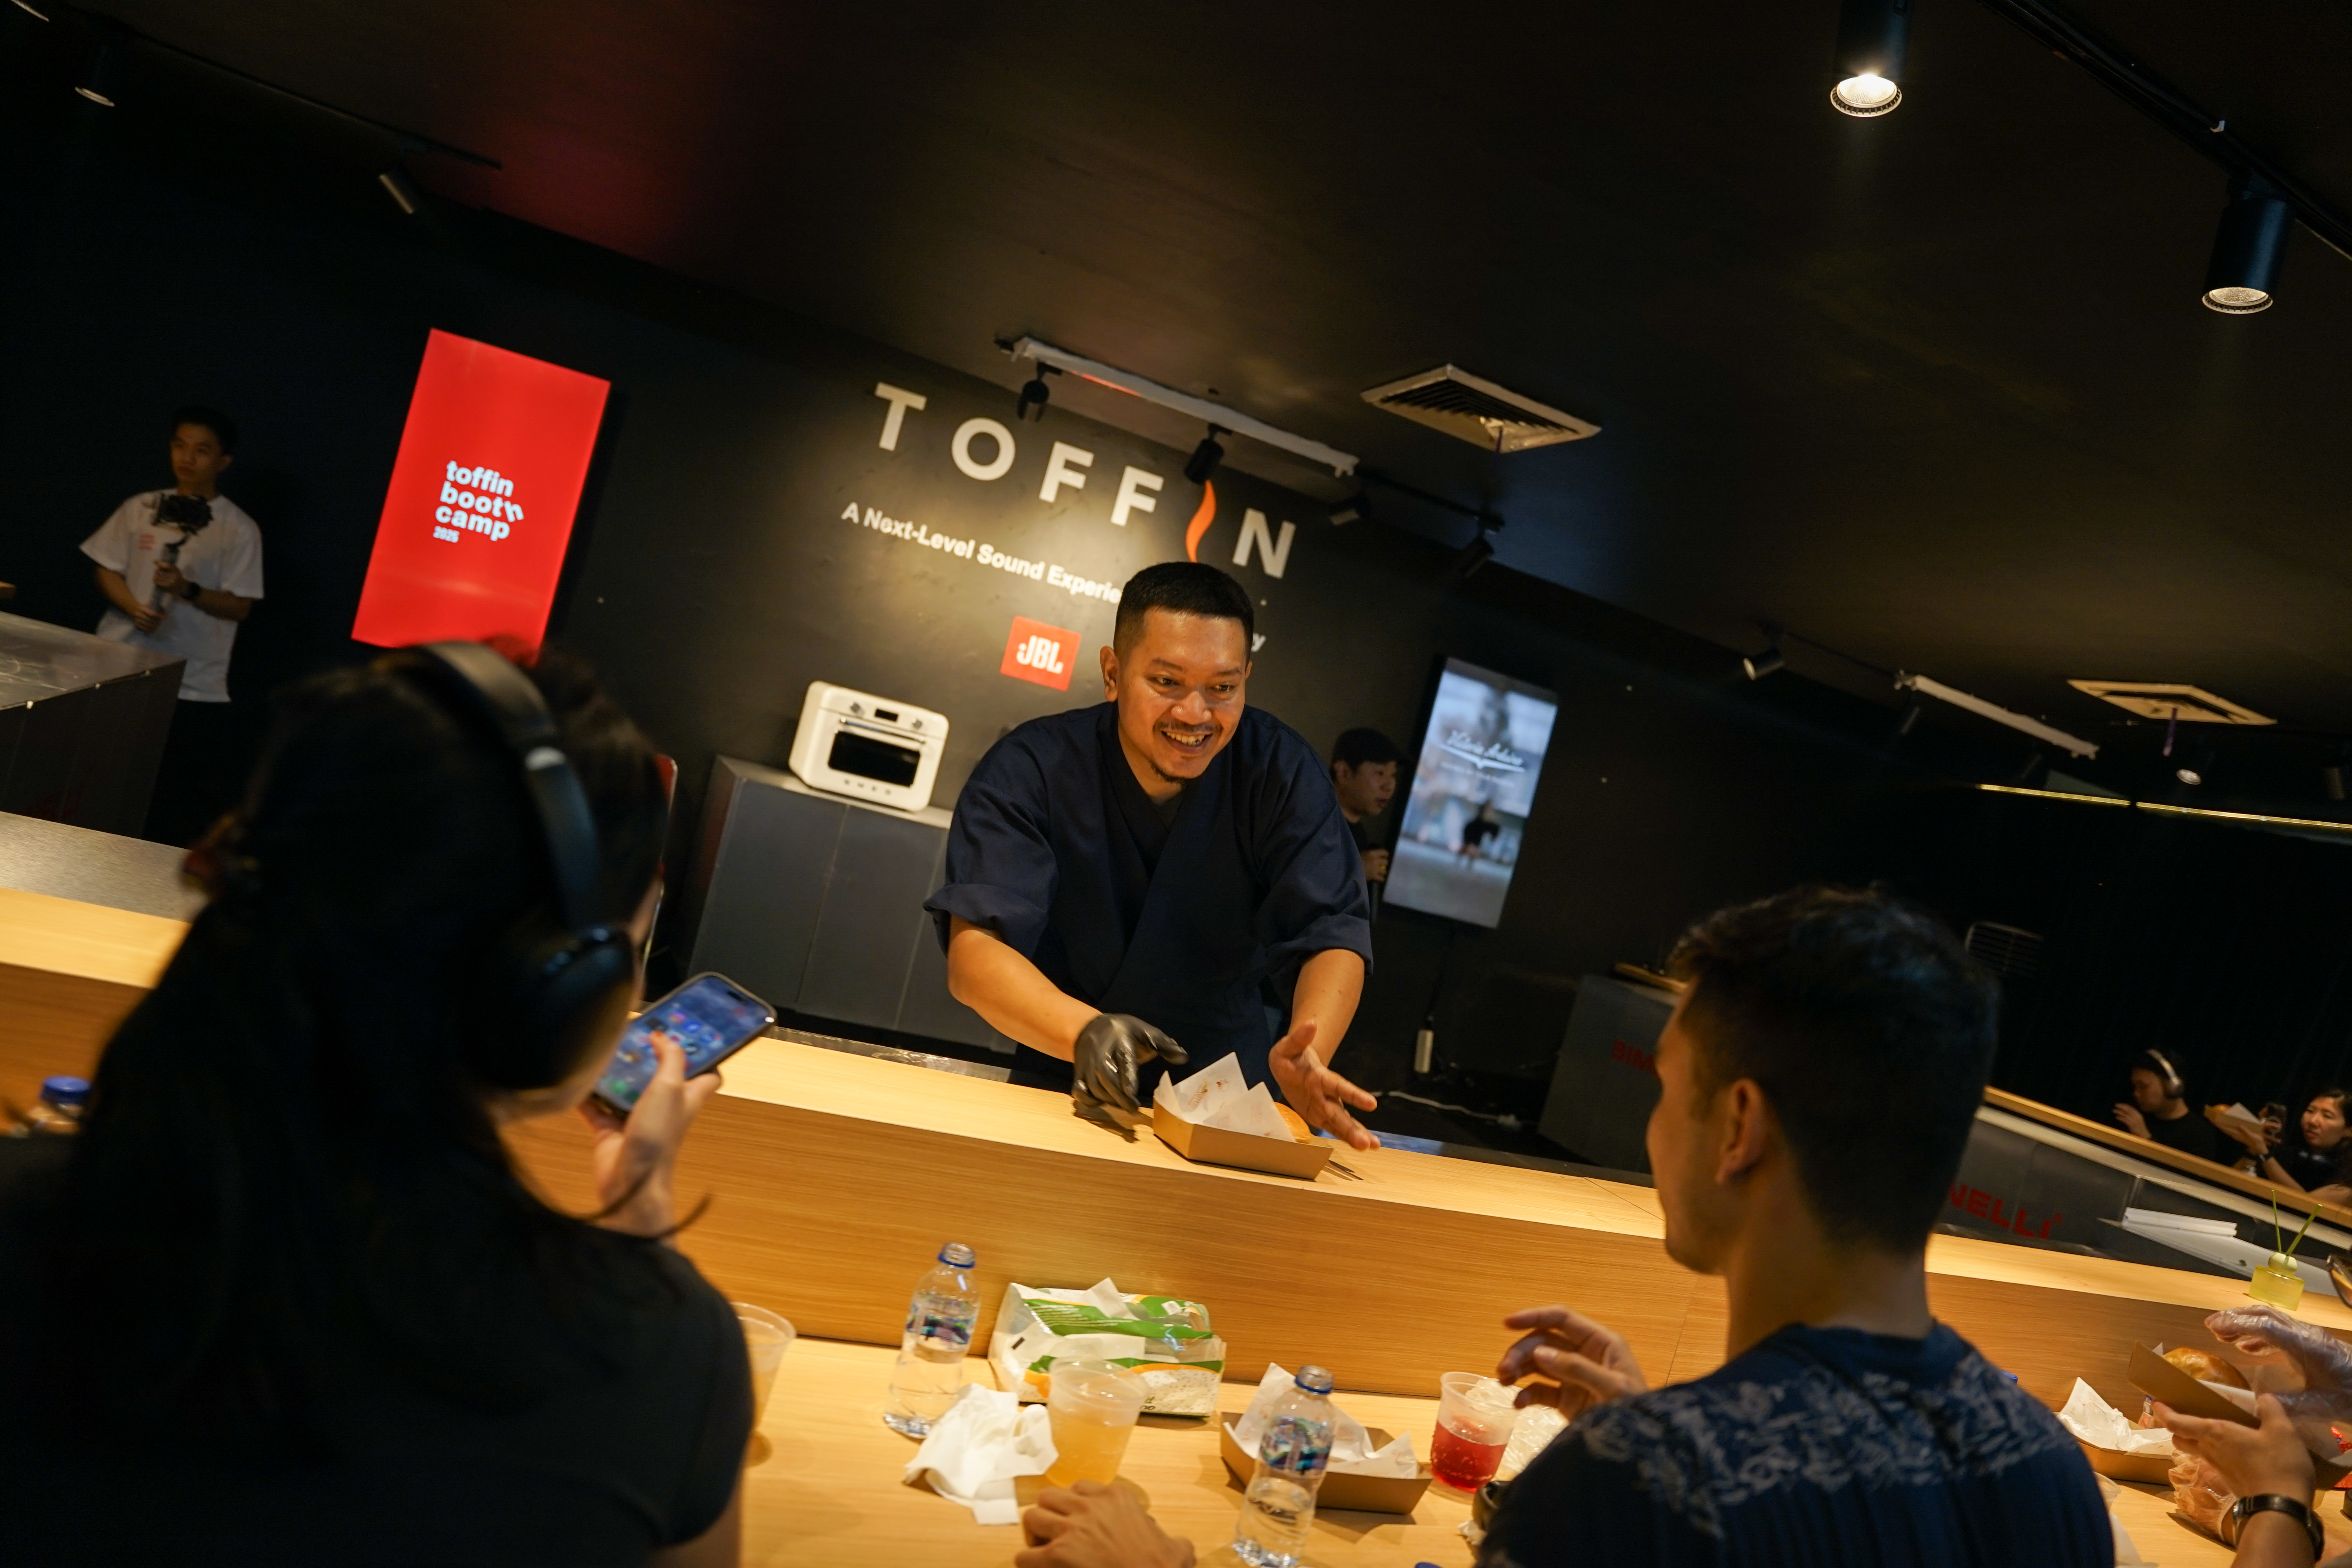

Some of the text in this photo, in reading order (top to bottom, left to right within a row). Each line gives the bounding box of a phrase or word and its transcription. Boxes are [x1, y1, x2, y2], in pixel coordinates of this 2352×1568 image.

[446, 460, 514, 497] toffin
[439, 481, 524, 522] booth
[433, 526, 460, 543] 2025
[435, 506, 510, 541] camp
[841, 502, 1122, 604] A Next-Level Sound Experie
[1016, 635, 1064, 675] JBL
[1611, 1040, 1658, 1076] SIM
[1951, 1184, 2051, 1240] NELLI
